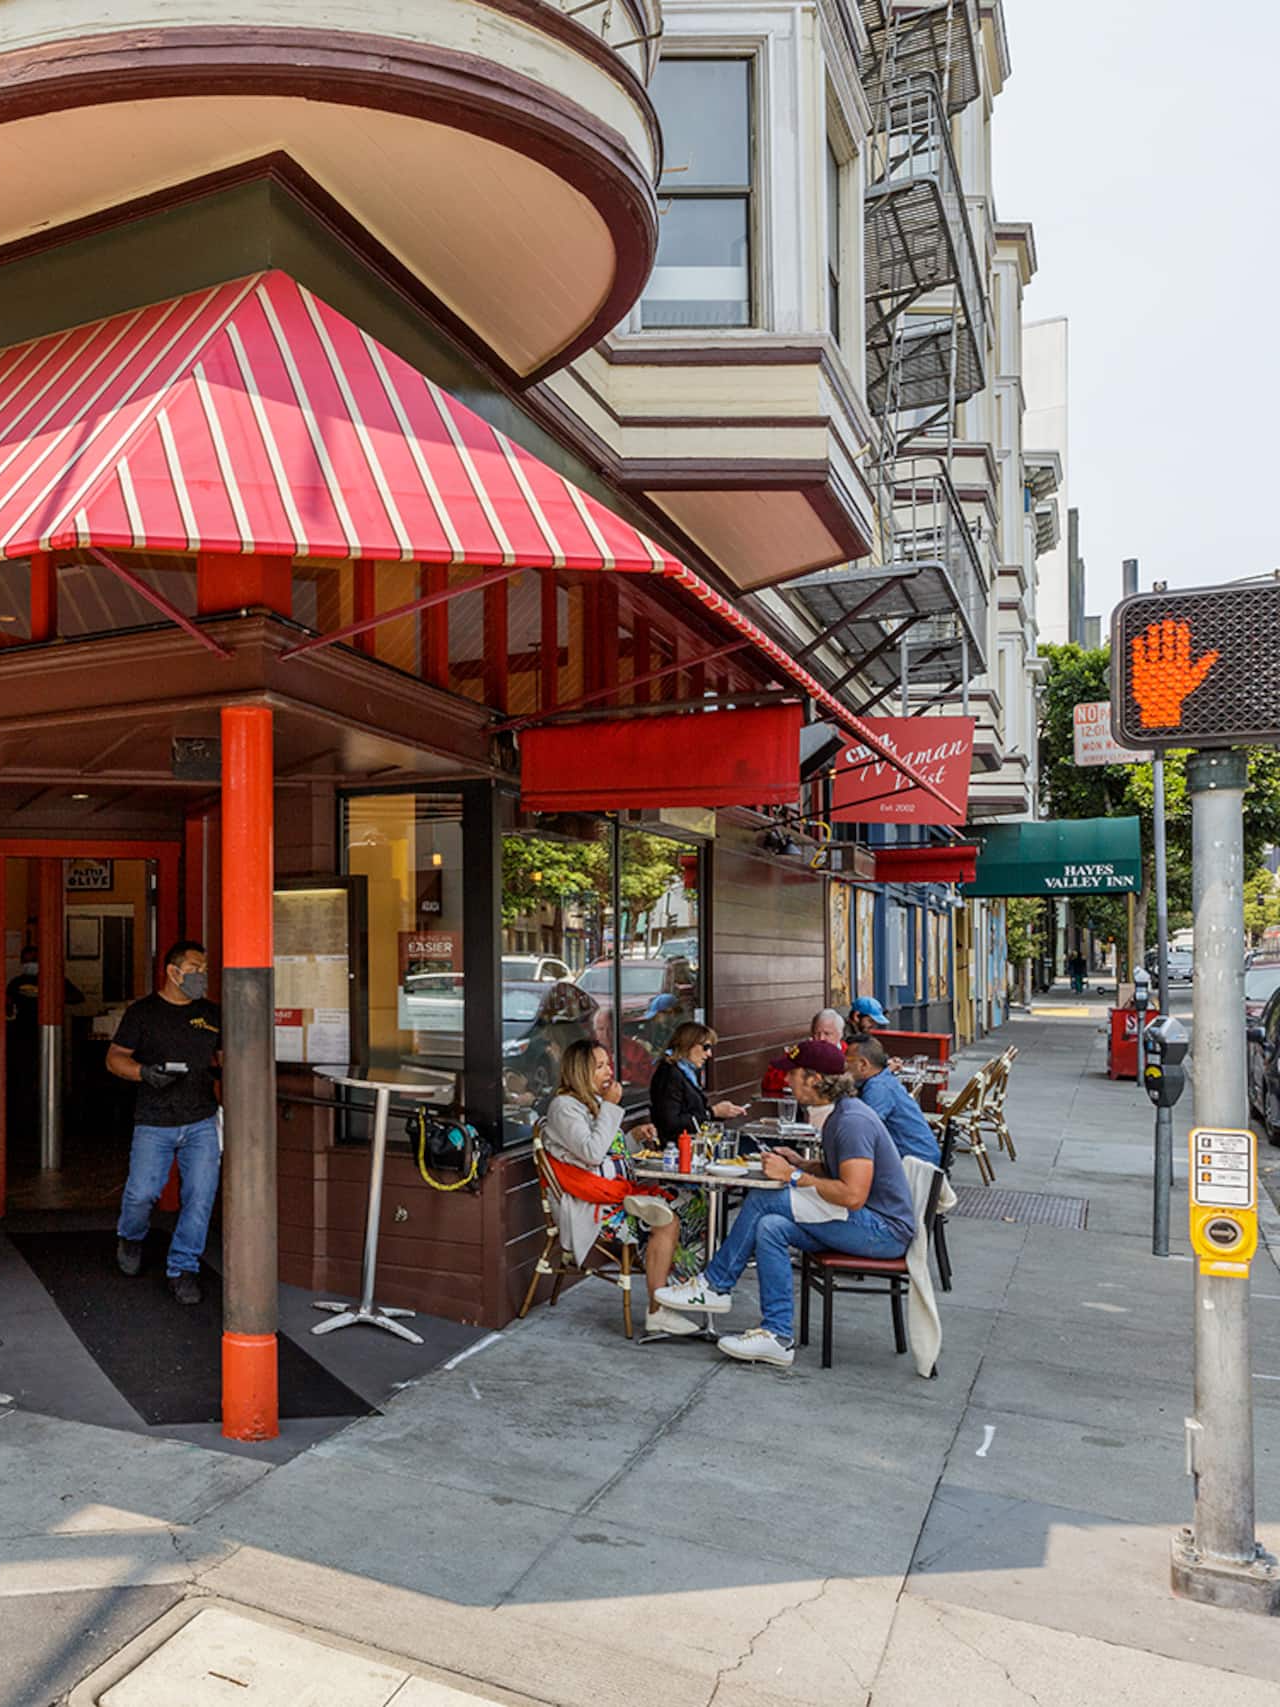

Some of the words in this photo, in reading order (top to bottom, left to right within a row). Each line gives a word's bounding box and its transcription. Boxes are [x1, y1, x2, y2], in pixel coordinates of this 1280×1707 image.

[1077, 704, 1099, 724] NO
[1063, 863, 1114, 876] HAYES
[1044, 876, 1102, 888] VALLEY
[1106, 875, 1134, 887] INN
[406, 940, 454, 954] EASIER
